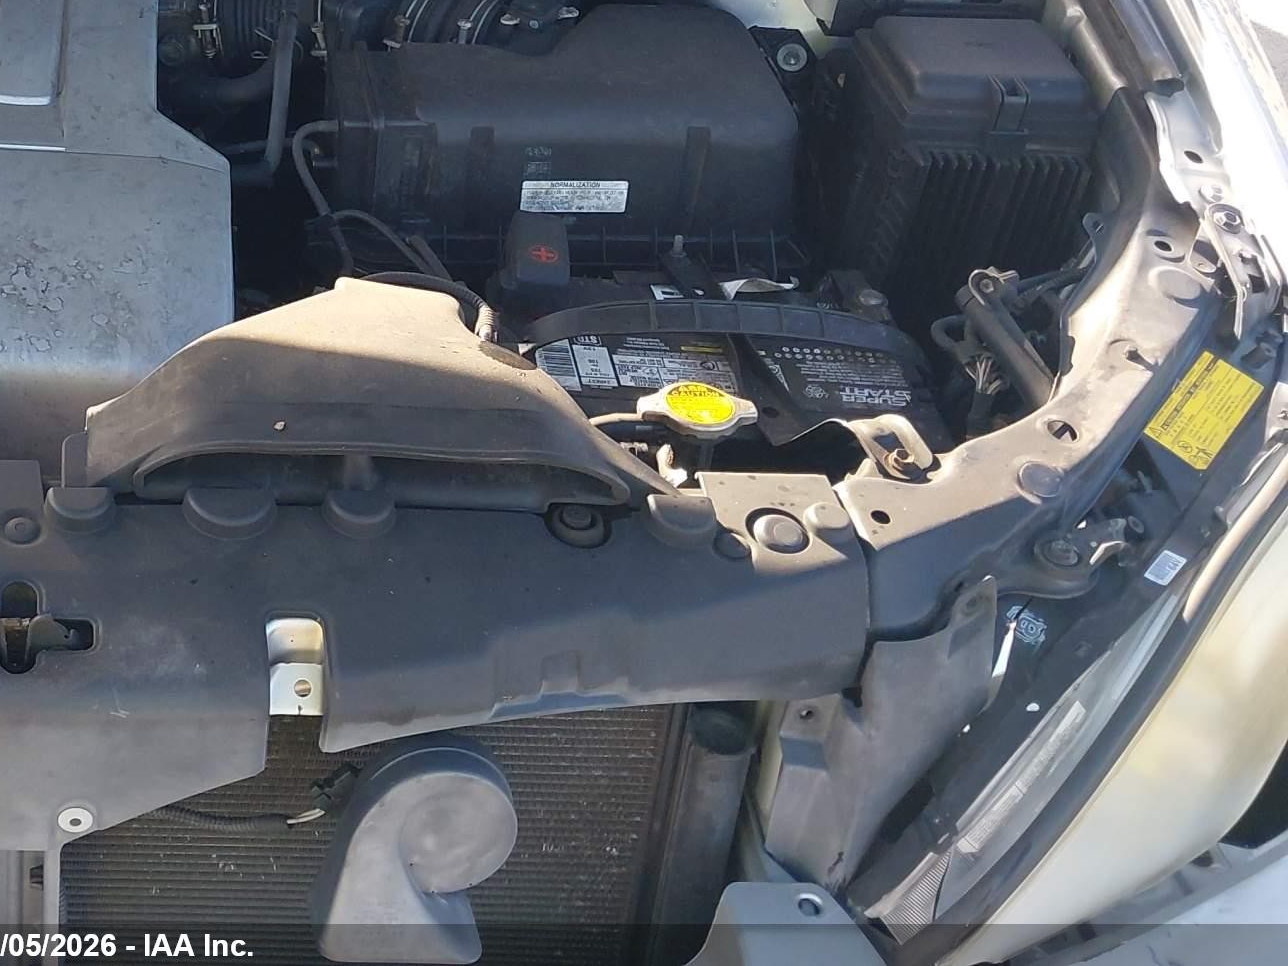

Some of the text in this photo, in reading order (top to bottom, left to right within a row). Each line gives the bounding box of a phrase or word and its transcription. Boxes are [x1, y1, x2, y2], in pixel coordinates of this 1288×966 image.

[550, 181, 601, 189] NORMALIZATION
[671, 389, 720, 398] CAUTION
[839, 387, 912, 397] START
[842, 394, 907, 407] SUPER
